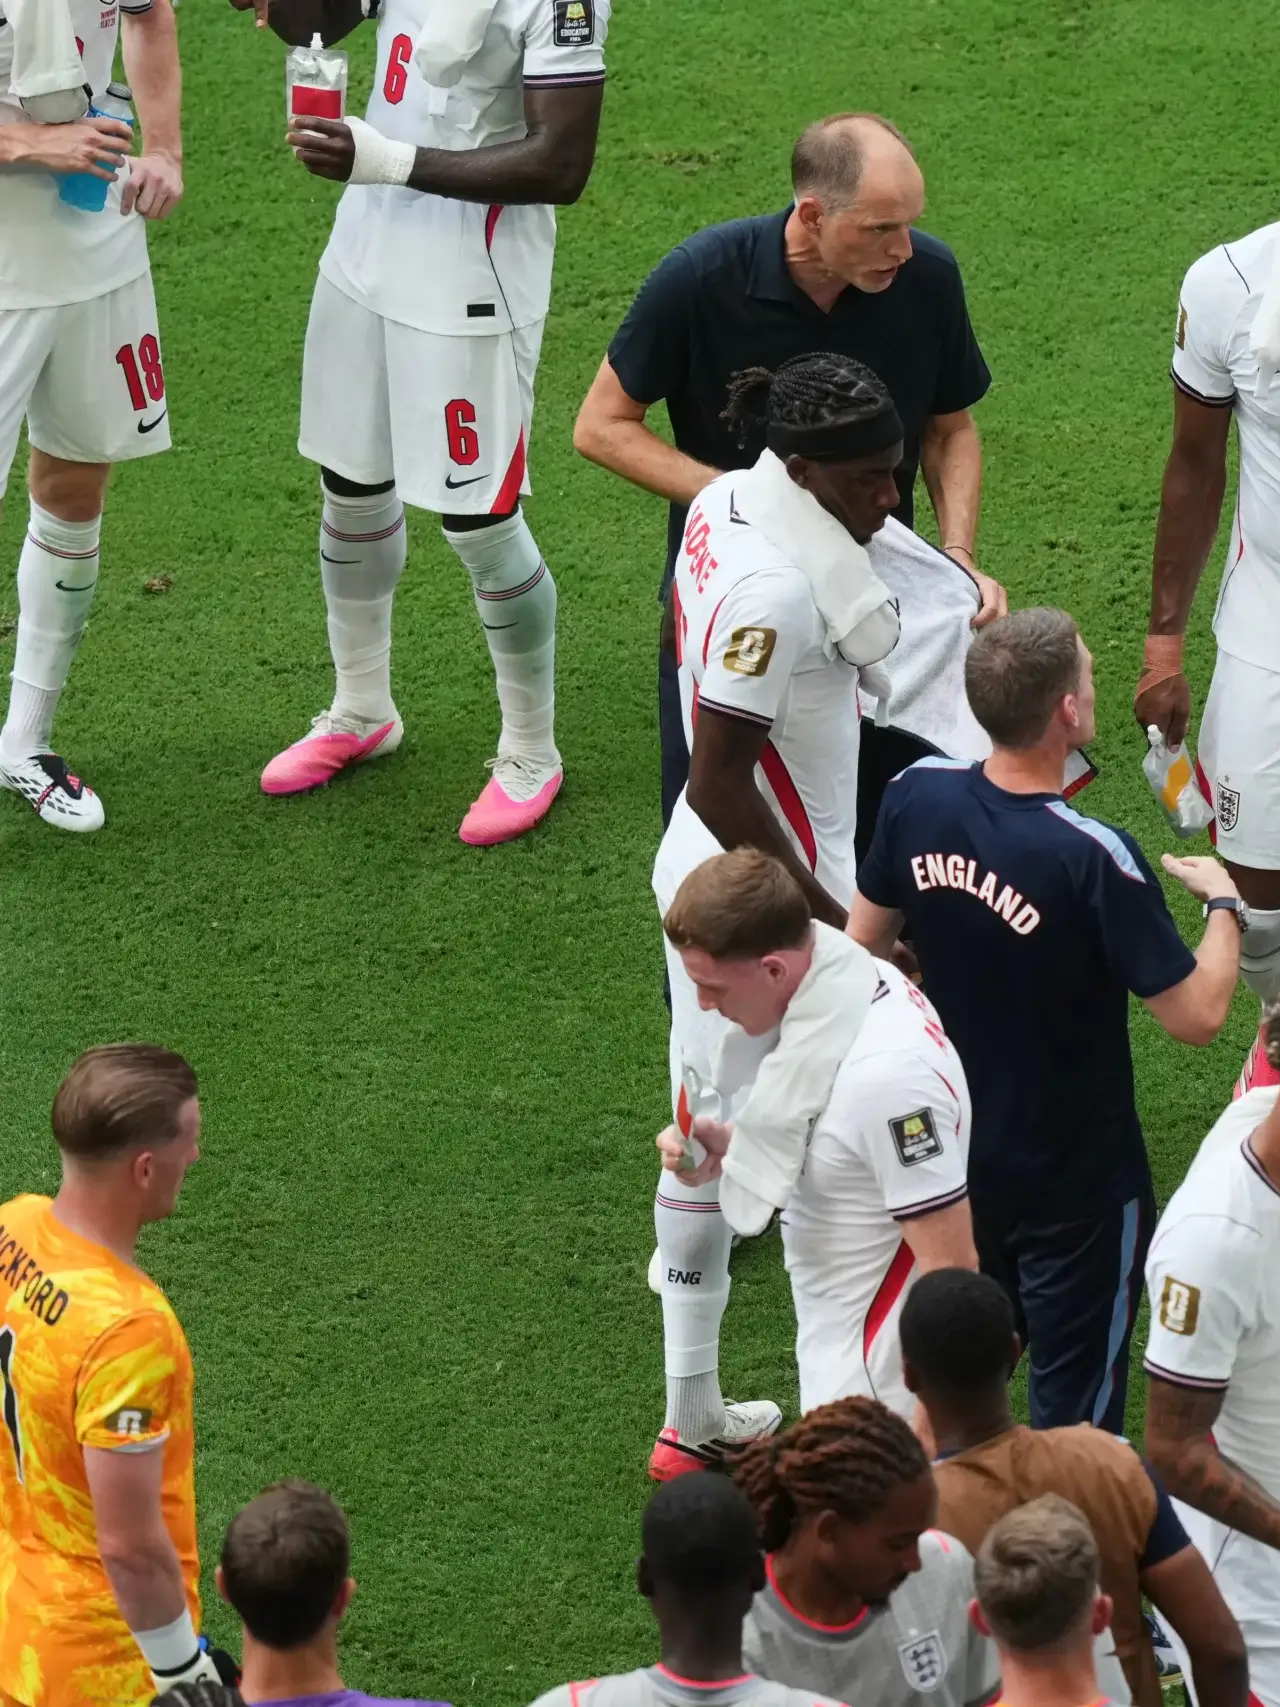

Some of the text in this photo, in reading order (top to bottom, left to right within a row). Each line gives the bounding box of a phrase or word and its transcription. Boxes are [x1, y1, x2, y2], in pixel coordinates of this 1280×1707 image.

[383, 33, 413, 105] 6
[115, 333, 164, 411] 18
[444, 398, 479, 466] 6
[910, 853, 1041, 935] ENGLAND
[667, 1268, 702, 1285] ENG
